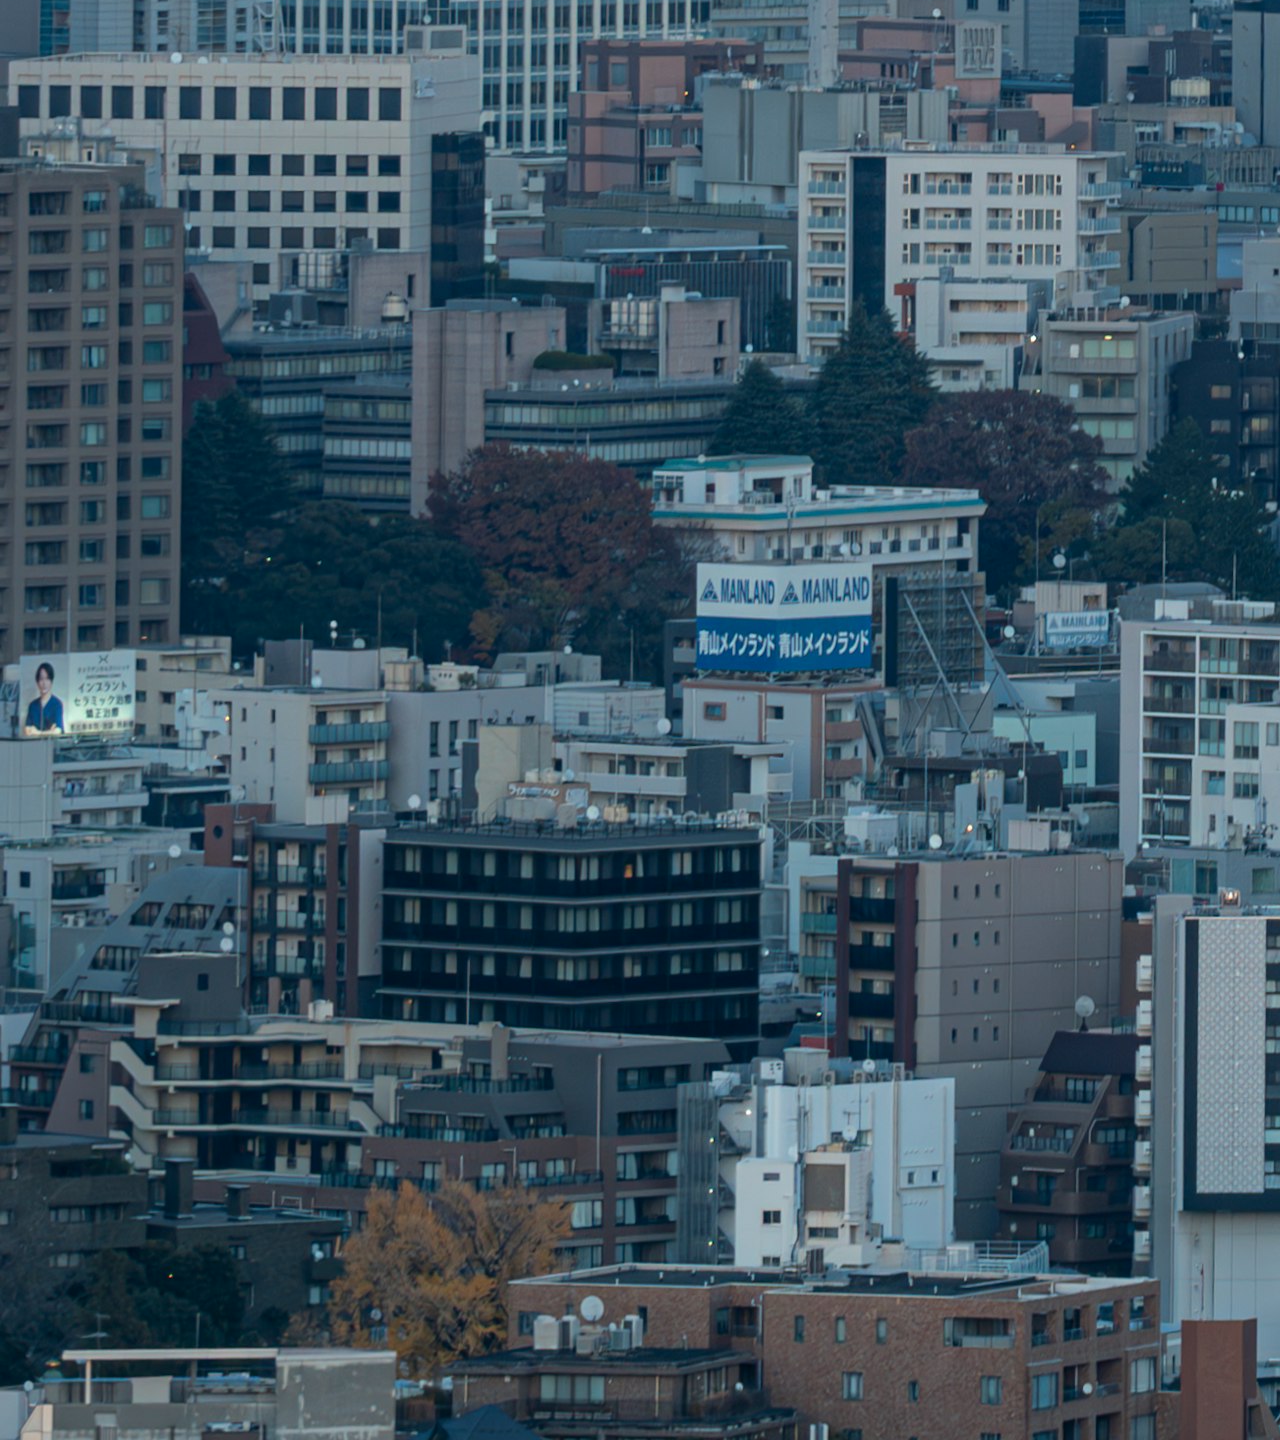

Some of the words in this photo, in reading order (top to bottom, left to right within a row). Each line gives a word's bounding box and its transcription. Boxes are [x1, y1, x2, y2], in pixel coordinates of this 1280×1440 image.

[720, 578, 776, 605] MAINLAND
[802, 576, 870, 603] MAINLAND
[1061, 614, 1106, 627] MAINLAND
[698, 629, 776, 658] 青山メインランド
[779, 629, 869, 659] 青山メインランド
